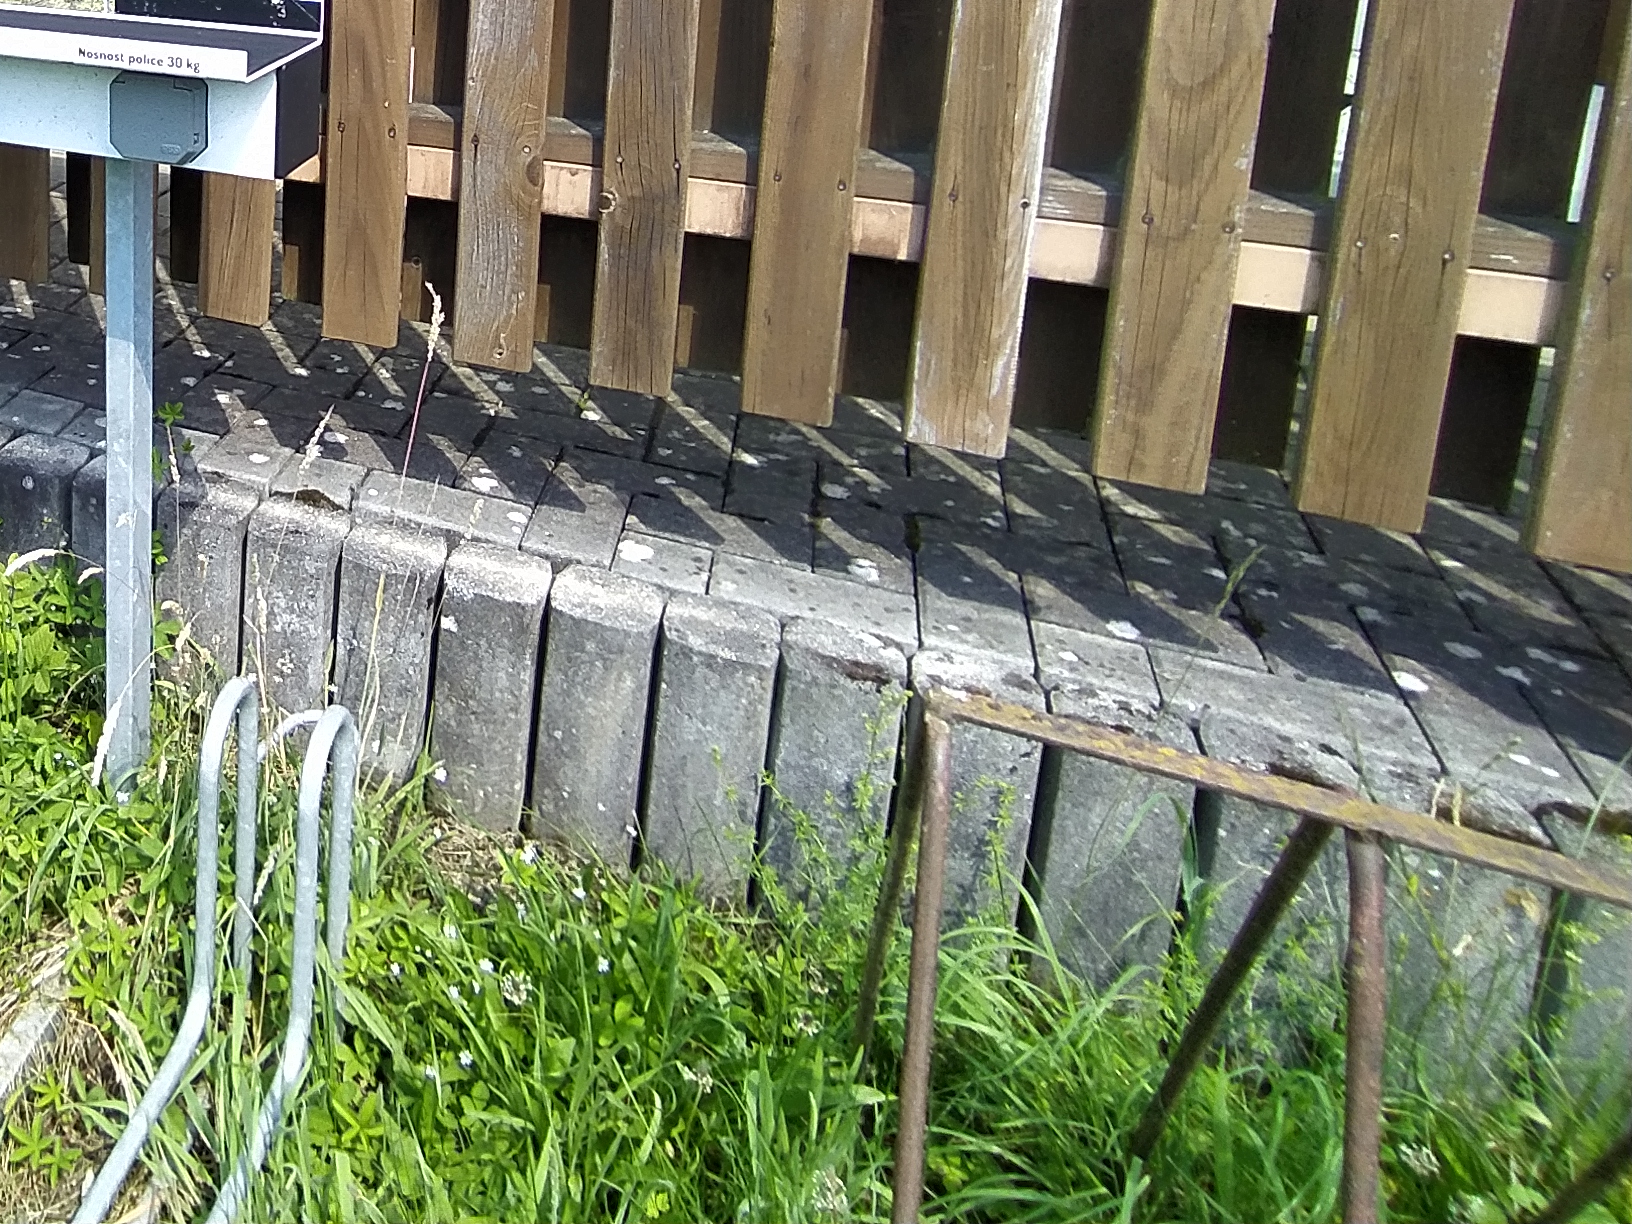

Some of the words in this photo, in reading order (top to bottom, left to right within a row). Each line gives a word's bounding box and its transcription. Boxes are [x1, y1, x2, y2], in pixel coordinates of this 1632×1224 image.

[78, 47, 125, 62] Nosnost
[128, 54, 164, 66] police
[167, 56, 183, 69] 30
[186, 58, 201, 74] kg
